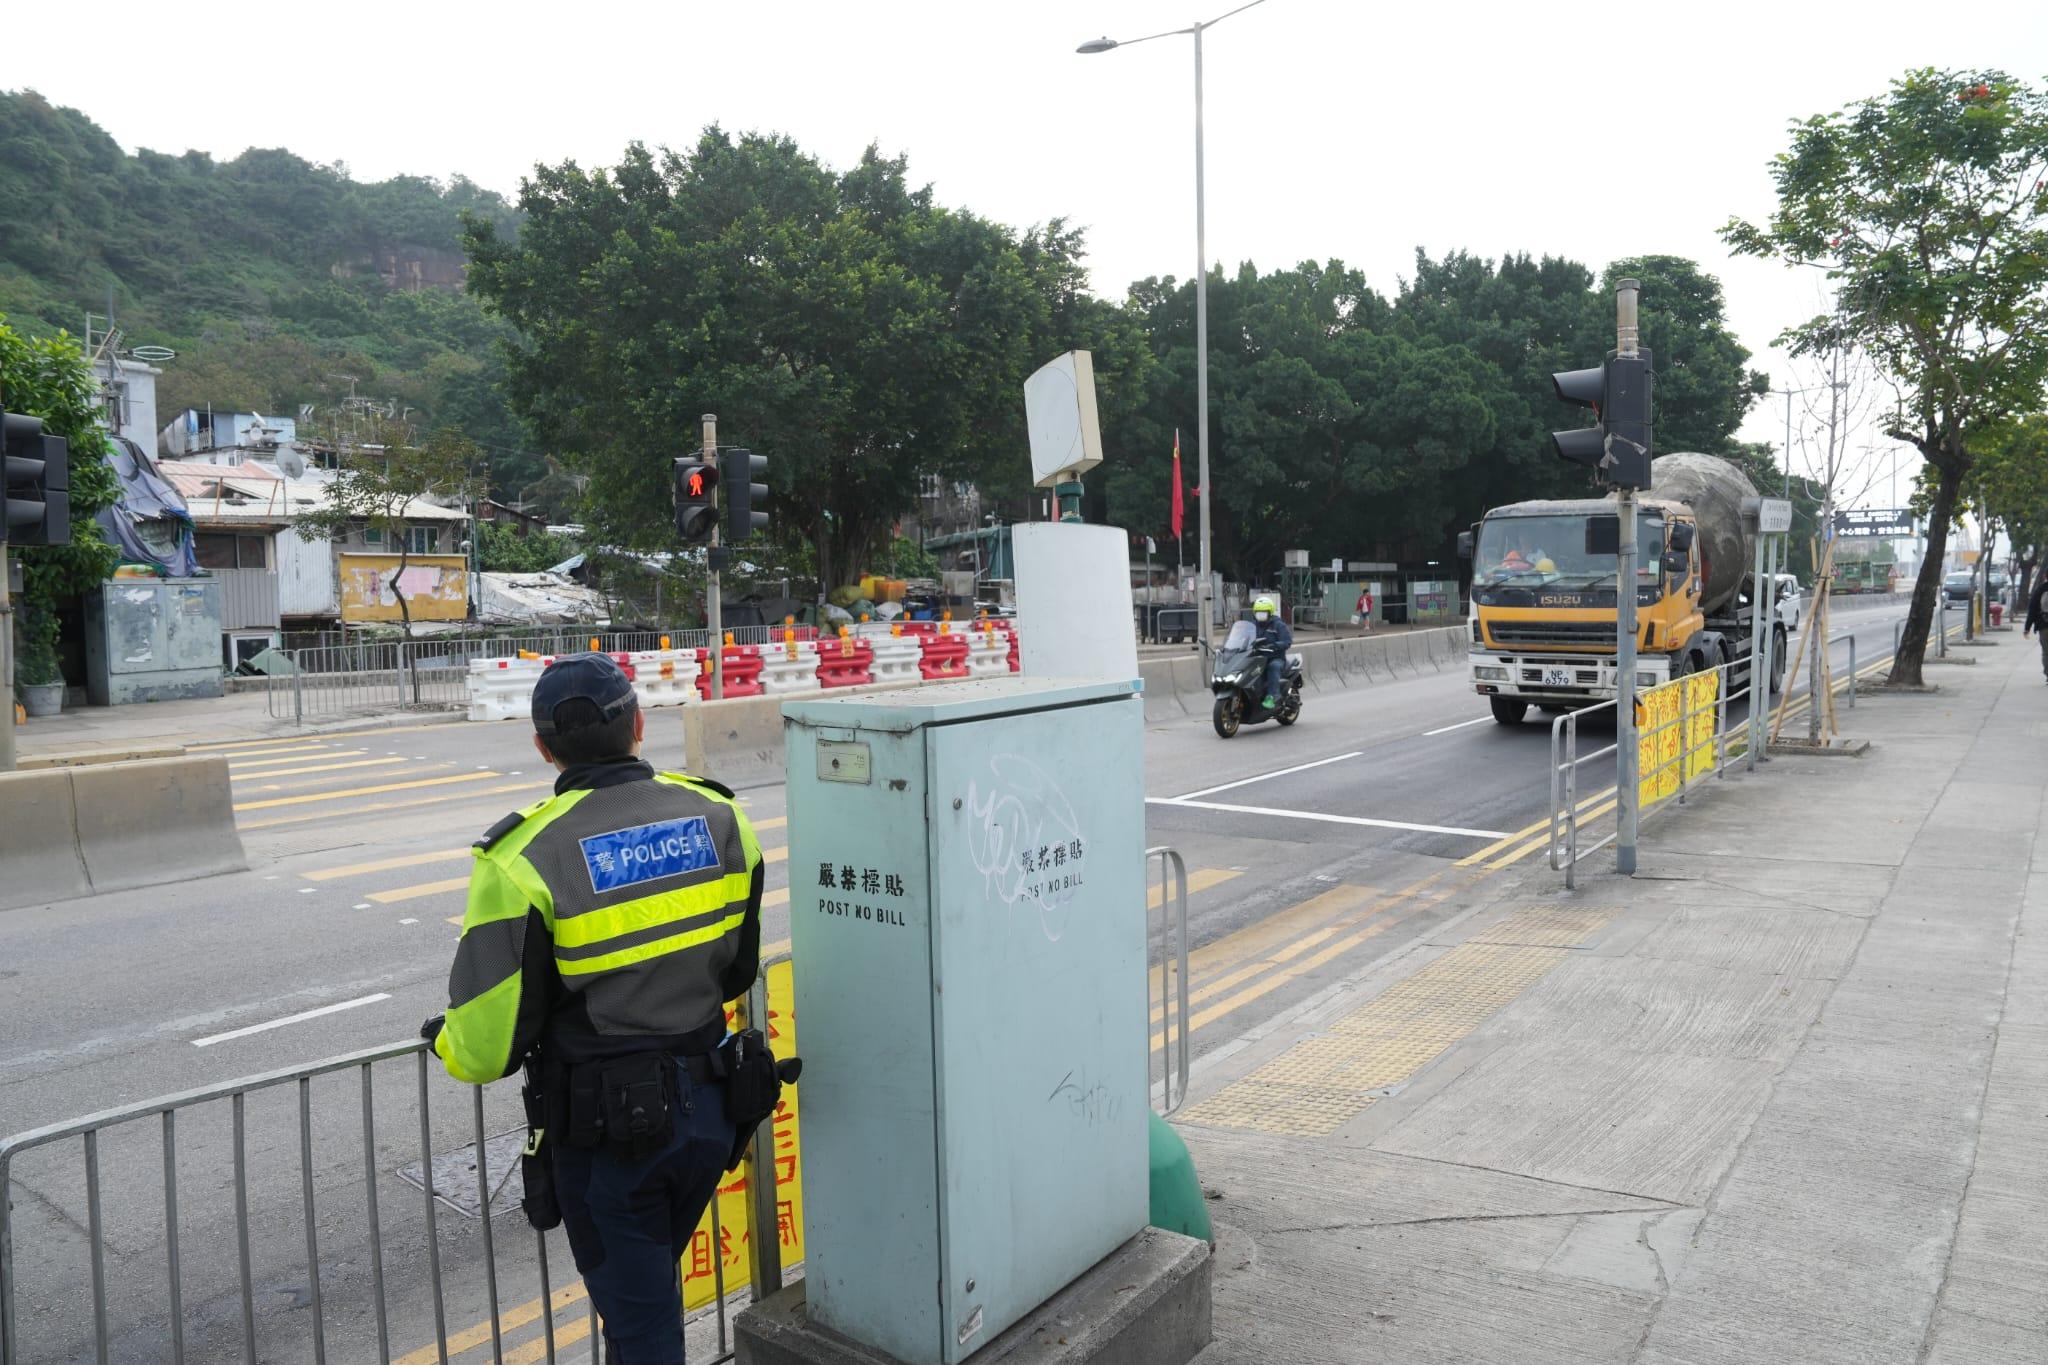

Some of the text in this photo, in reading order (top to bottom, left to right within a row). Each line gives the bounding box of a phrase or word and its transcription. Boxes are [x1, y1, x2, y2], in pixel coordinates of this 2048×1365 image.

[1541, 595, 1580, 604] ISUZU
[1545, 677, 1569, 685] 6379
[595, 852, 616, 872] 警
[621, 837, 692, 866] POLICE
[818, 862, 904, 897] 嚴禁標貼
[1048, 879, 1060, 894] NO
[1063, 873, 1083, 889] BILL
[819, 899, 905, 927] POST NO BILL
